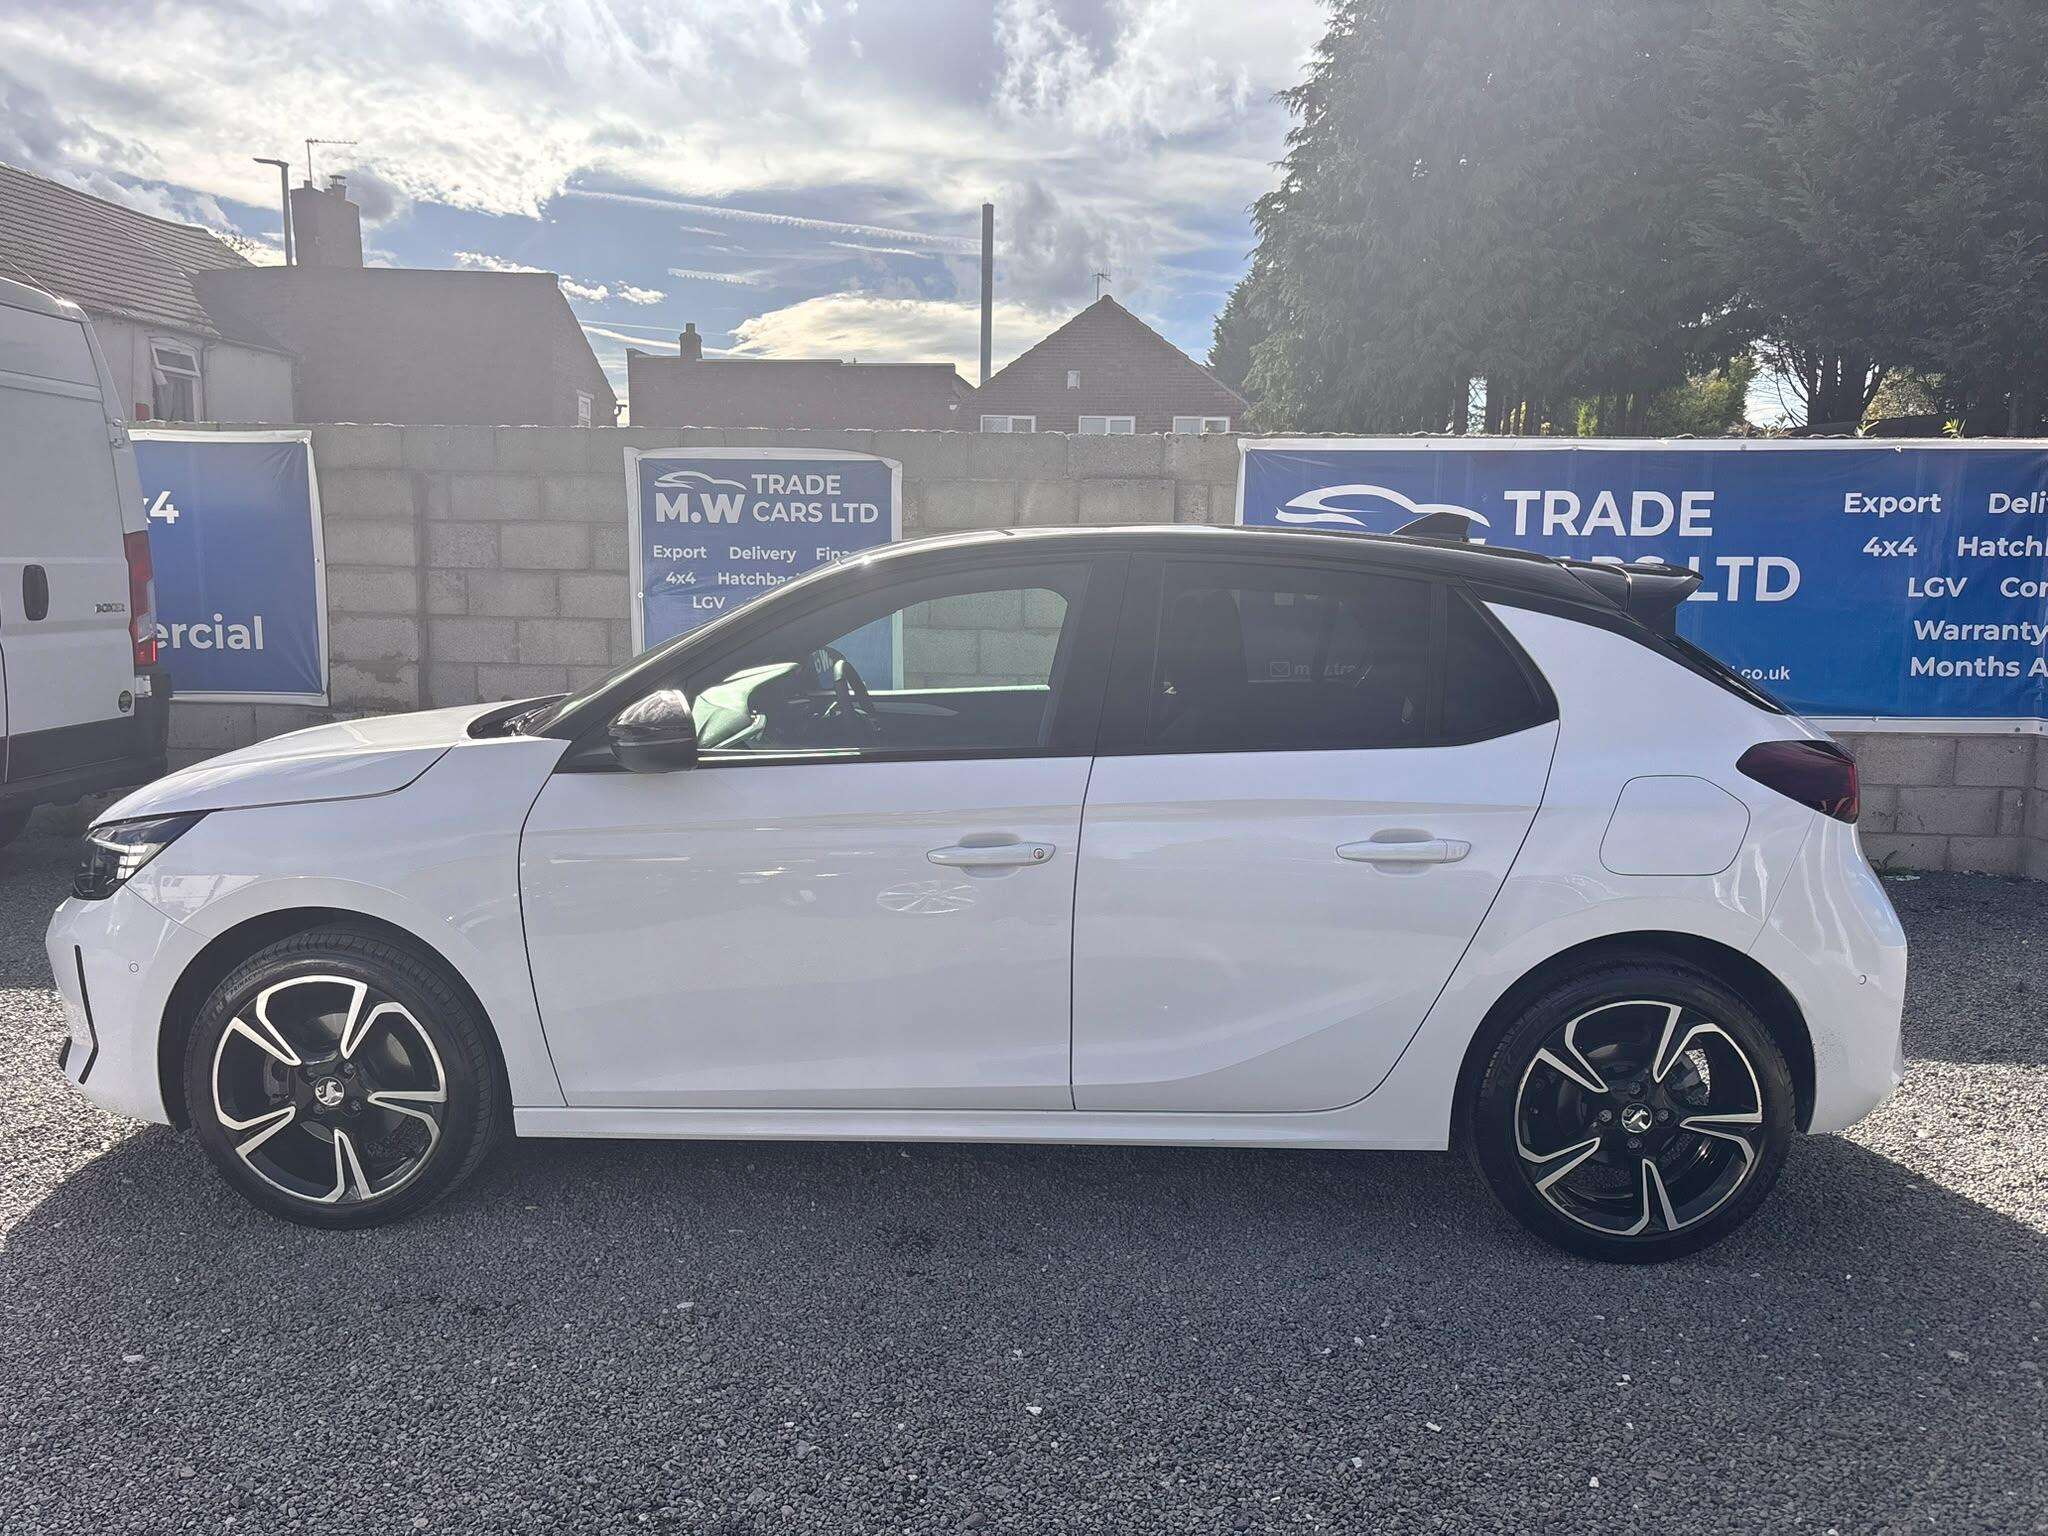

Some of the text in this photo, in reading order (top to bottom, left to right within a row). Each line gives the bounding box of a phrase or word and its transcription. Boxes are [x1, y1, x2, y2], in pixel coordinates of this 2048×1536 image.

[751, 473, 841, 495] TRADE
[655, 492, 746, 524] M.W
[752, 501, 879, 523] CARS LTD
[1504, 490, 1715, 537] TRADE
[1844, 491, 2048, 518] Export Deli
[653, 545, 707, 560] Export
[729, 546, 797, 563] Delivery
[1862, 535, 2048, 557] 4x4 Hatch
[666, 572, 697, 584] 4x4
[1908, 577, 1968, 598] LGV
[692, 596, 725, 609] LGV
[1914, 620, 2048, 646] Warranty
[1910, 656, 2021, 678] Months
